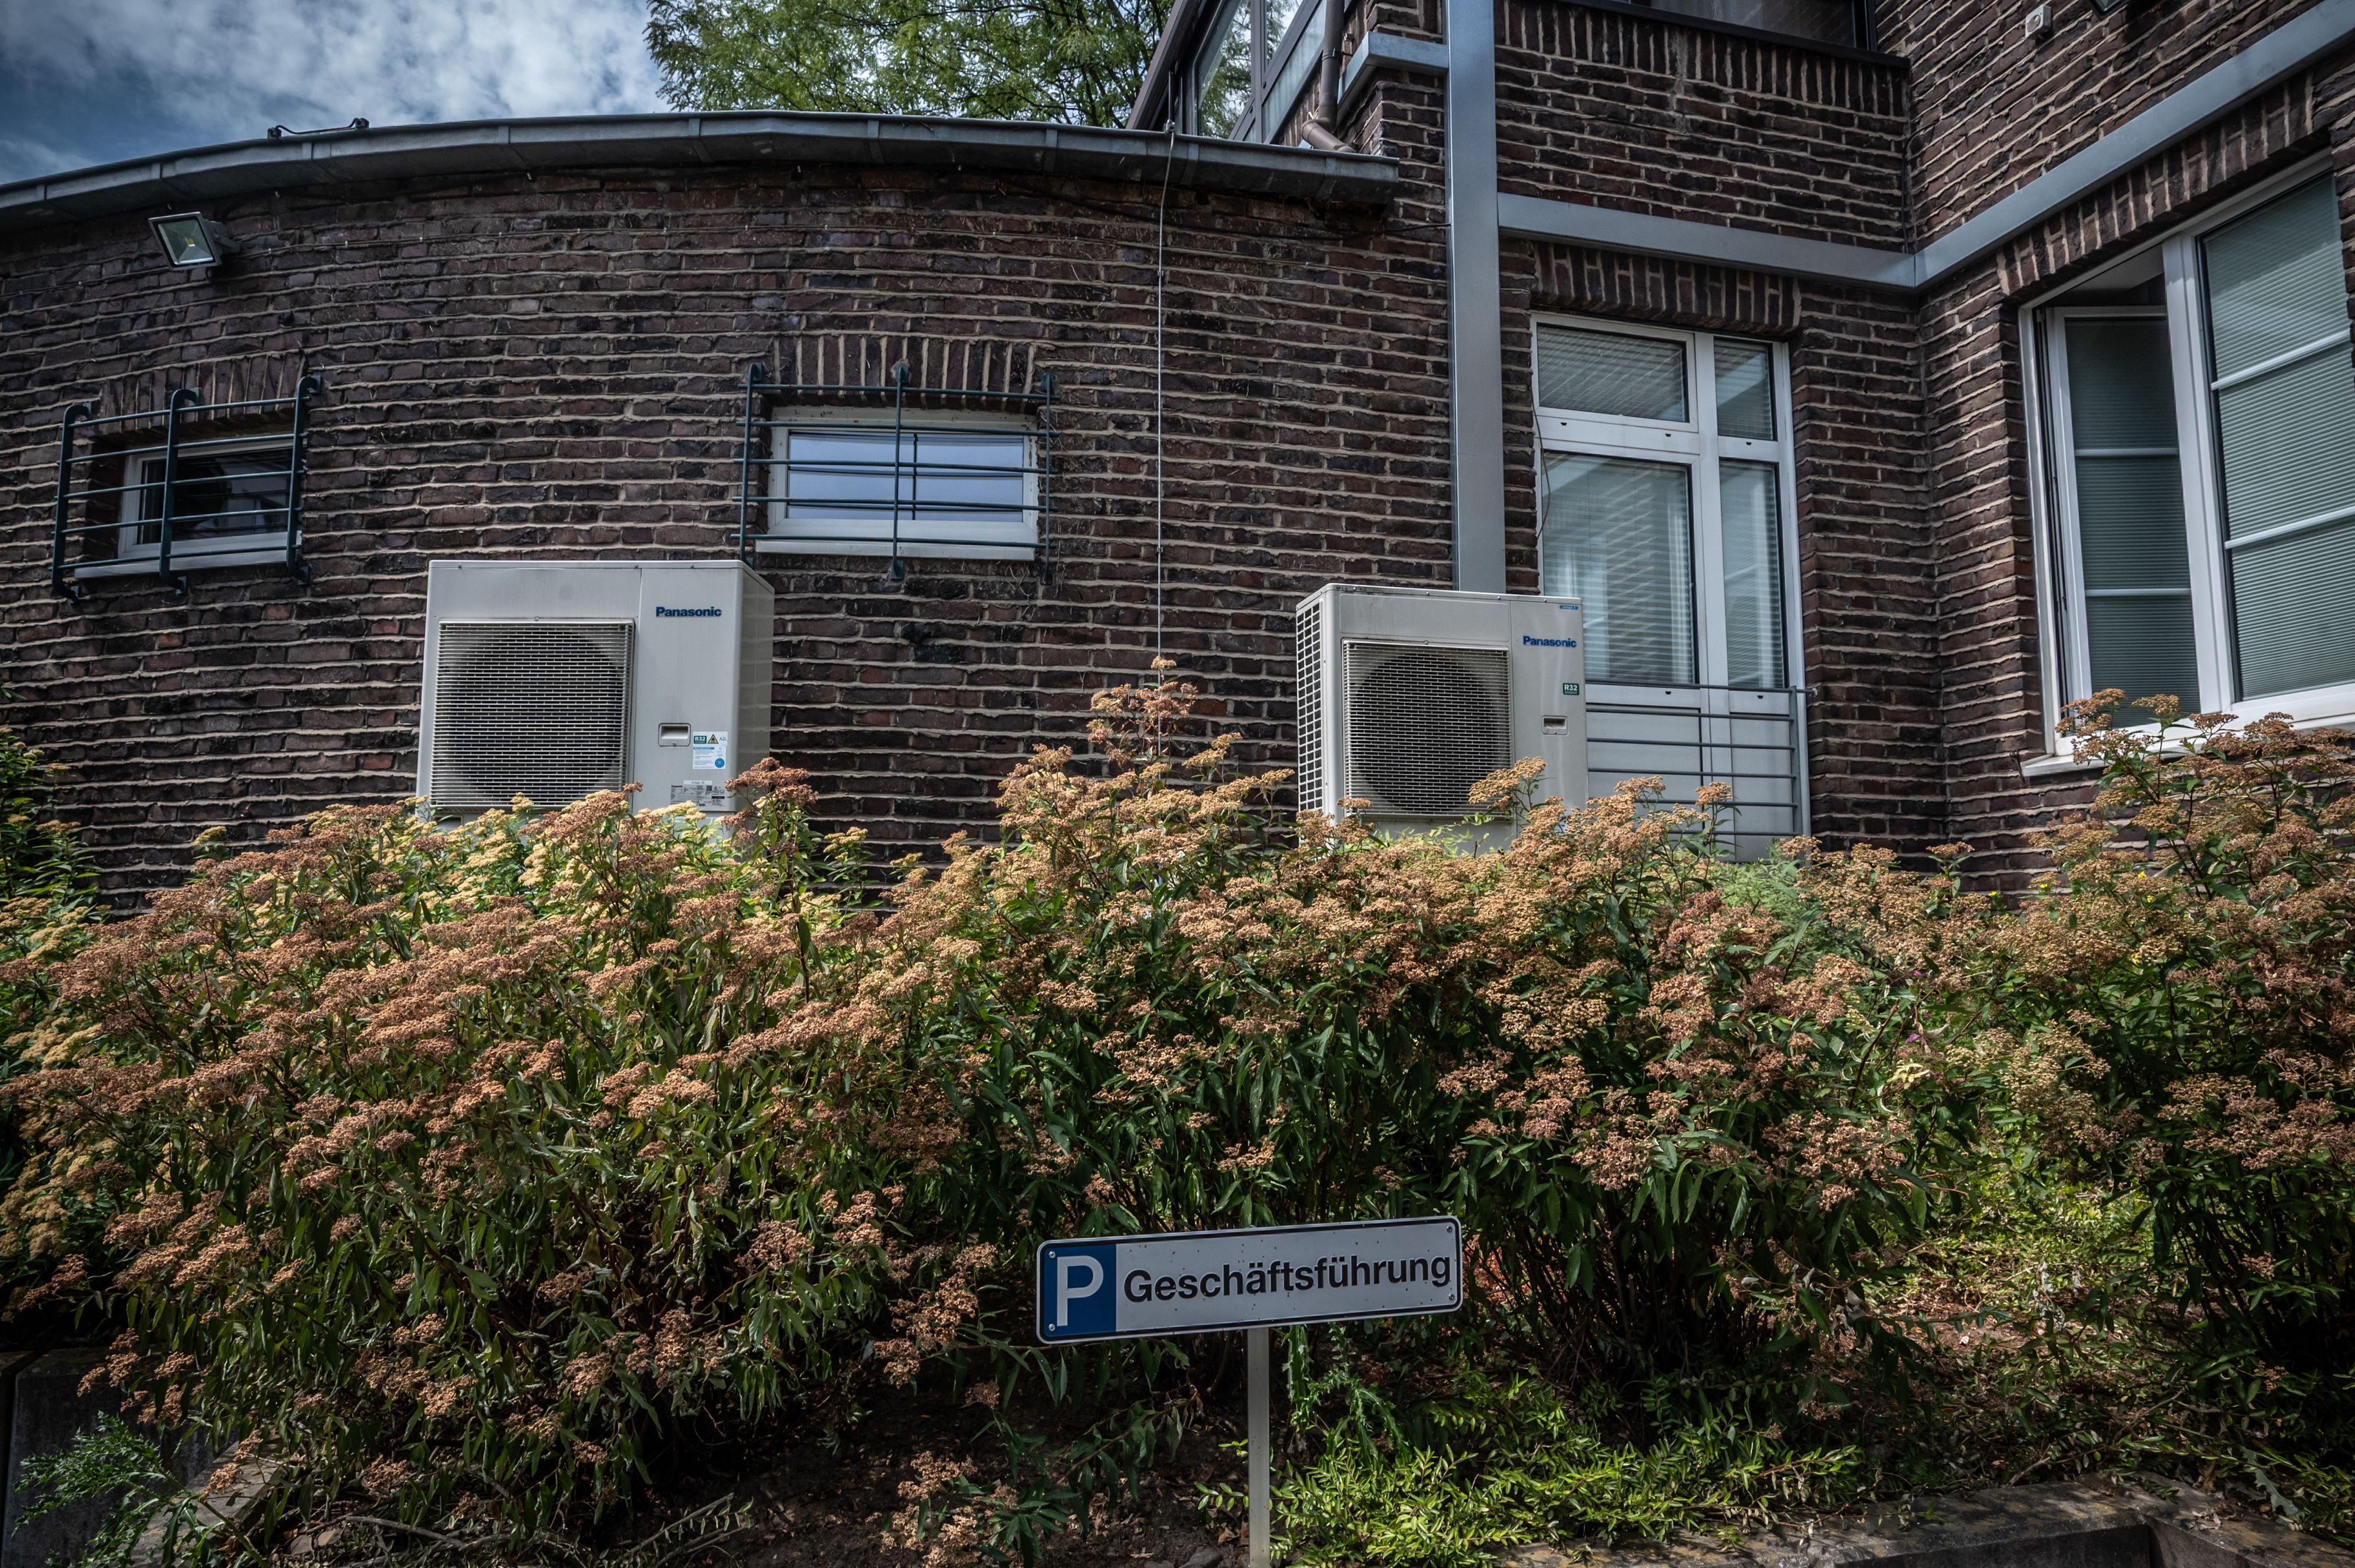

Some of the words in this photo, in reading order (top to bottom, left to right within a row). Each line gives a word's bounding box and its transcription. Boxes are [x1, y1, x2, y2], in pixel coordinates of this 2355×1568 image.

[655, 606, 722, 617] Panasonic
[1523, 636, 1577, 648] Panasonic
[1057, 1255, 1104, 1327] P
[1124, 1255, 1451, 1303] Geschäftsführung
